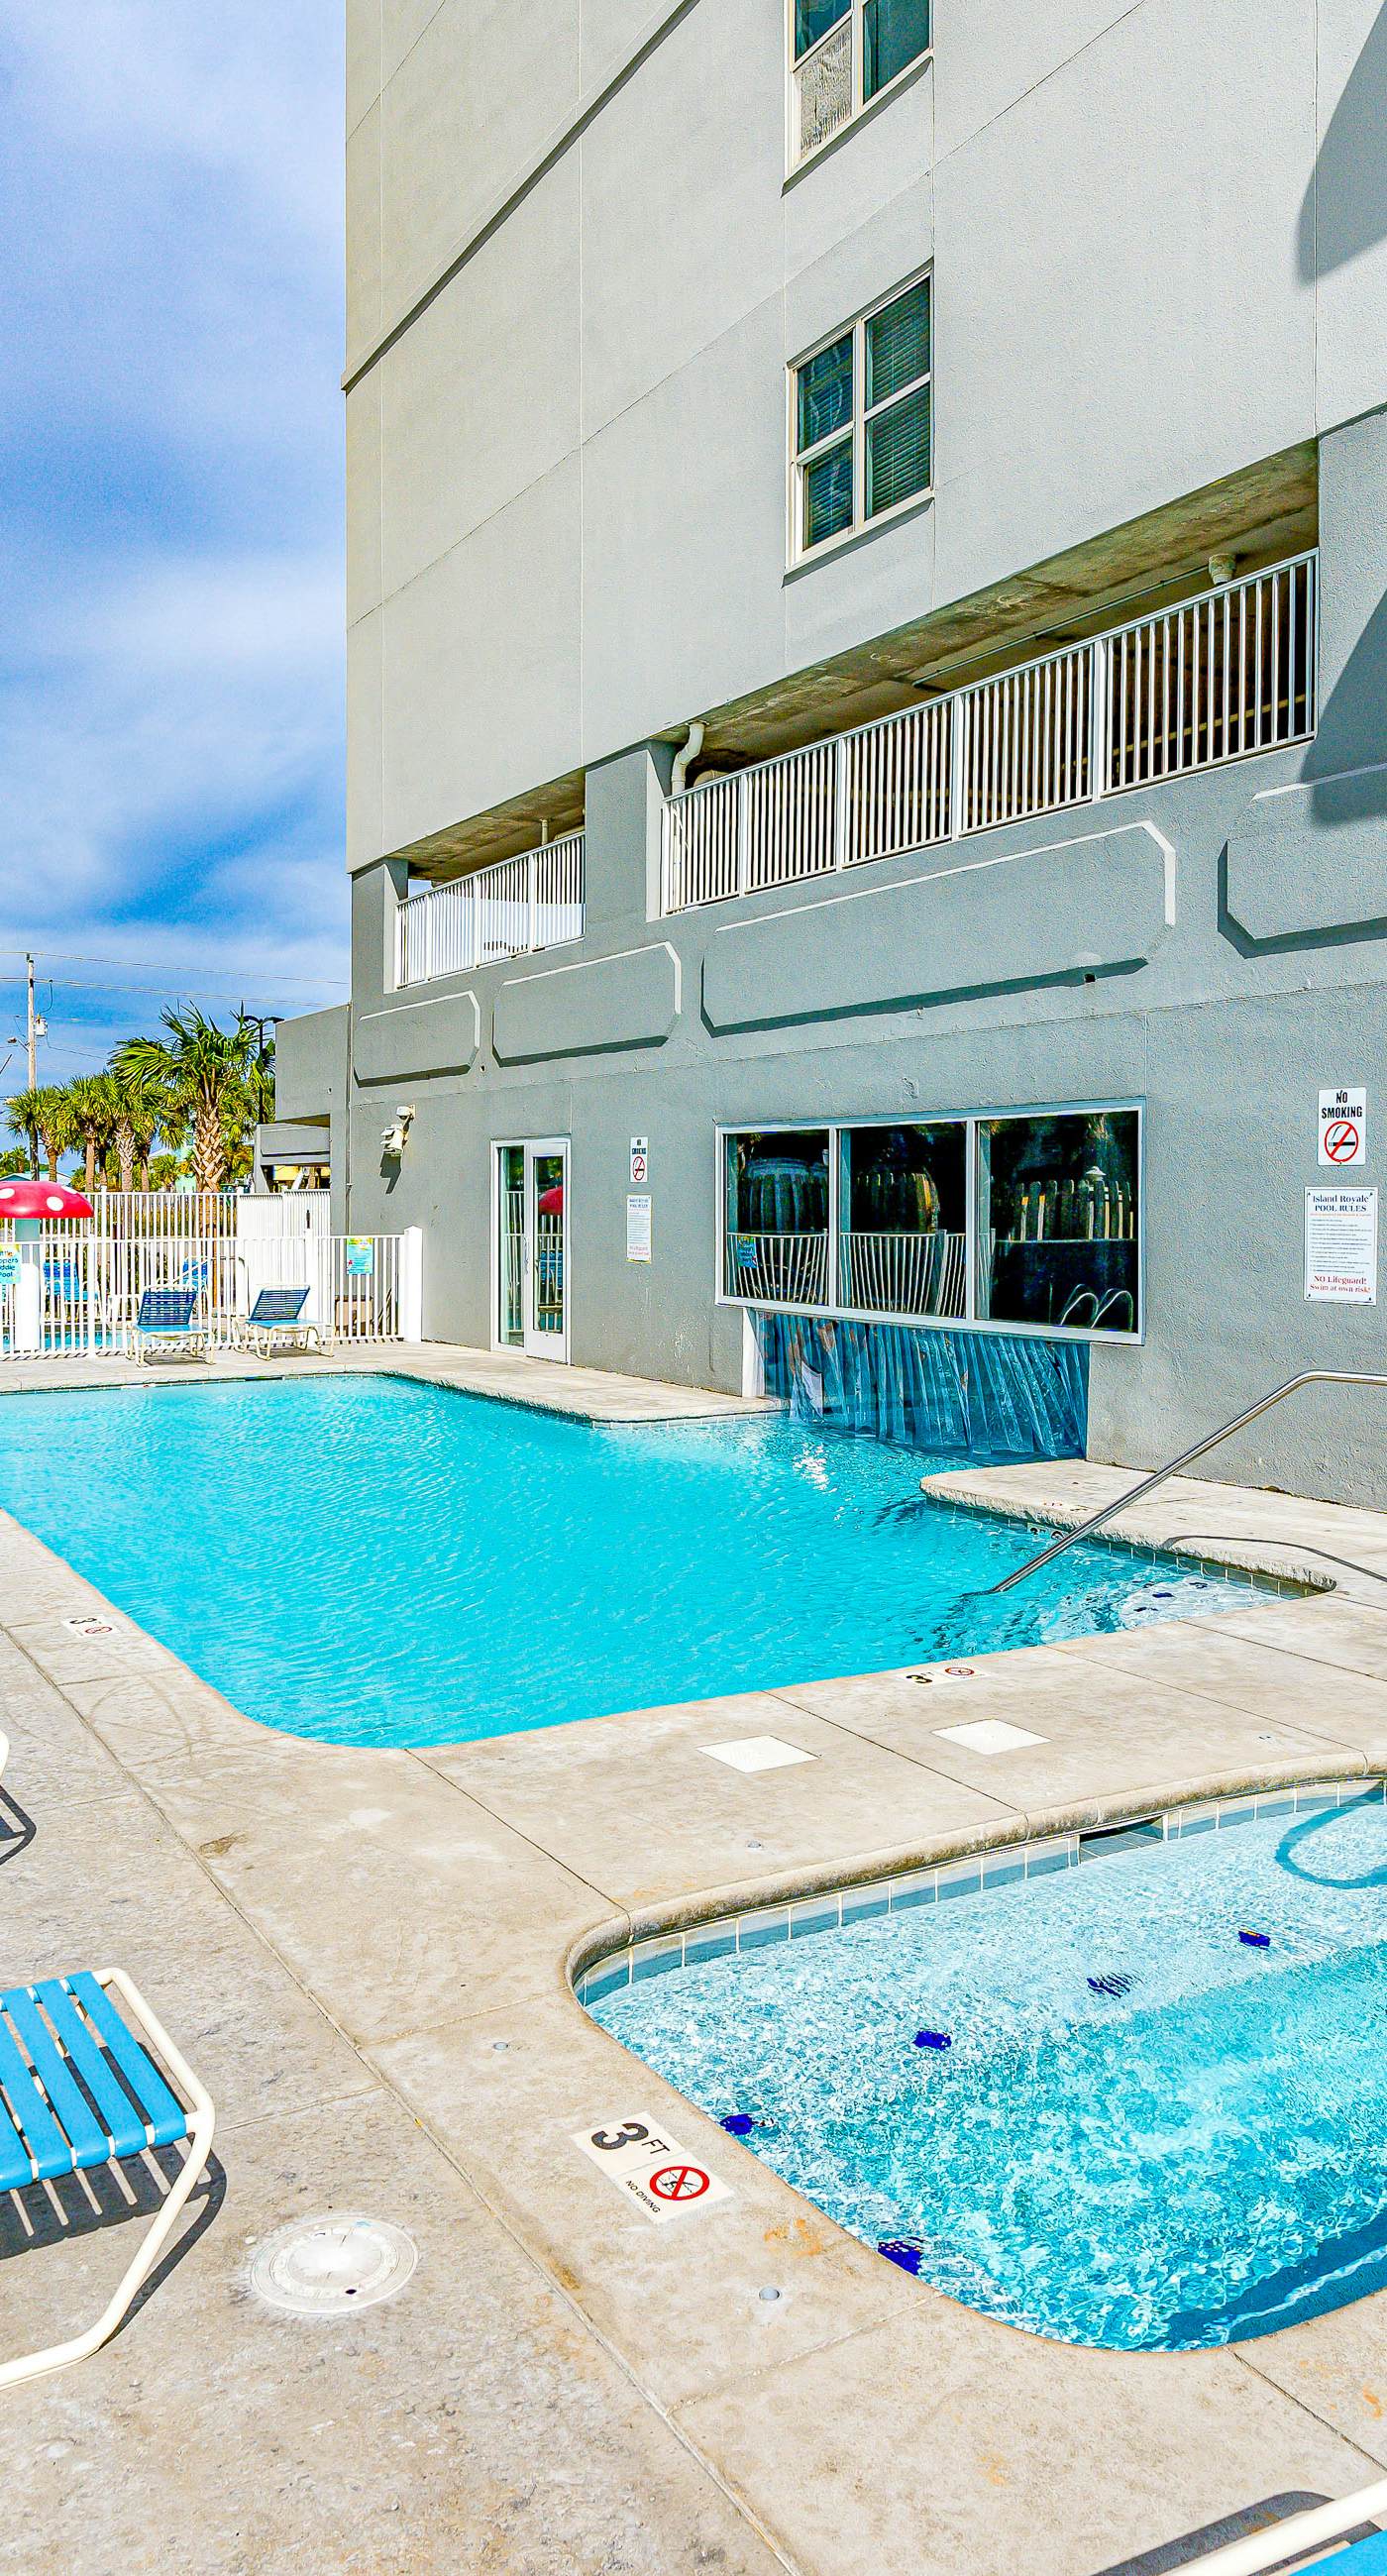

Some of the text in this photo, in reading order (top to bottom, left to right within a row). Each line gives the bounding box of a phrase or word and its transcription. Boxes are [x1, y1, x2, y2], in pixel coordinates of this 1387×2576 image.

[1335, 1091, 1348, 1104] NO
[1321, 1106, 1363, 1120] SMOKING
[1313, 1194, 1369, 1205] Island Royale
[591, 2122, 671, 2154] 3 FT
[626, 2180, 661, 2213] NO DIVING
